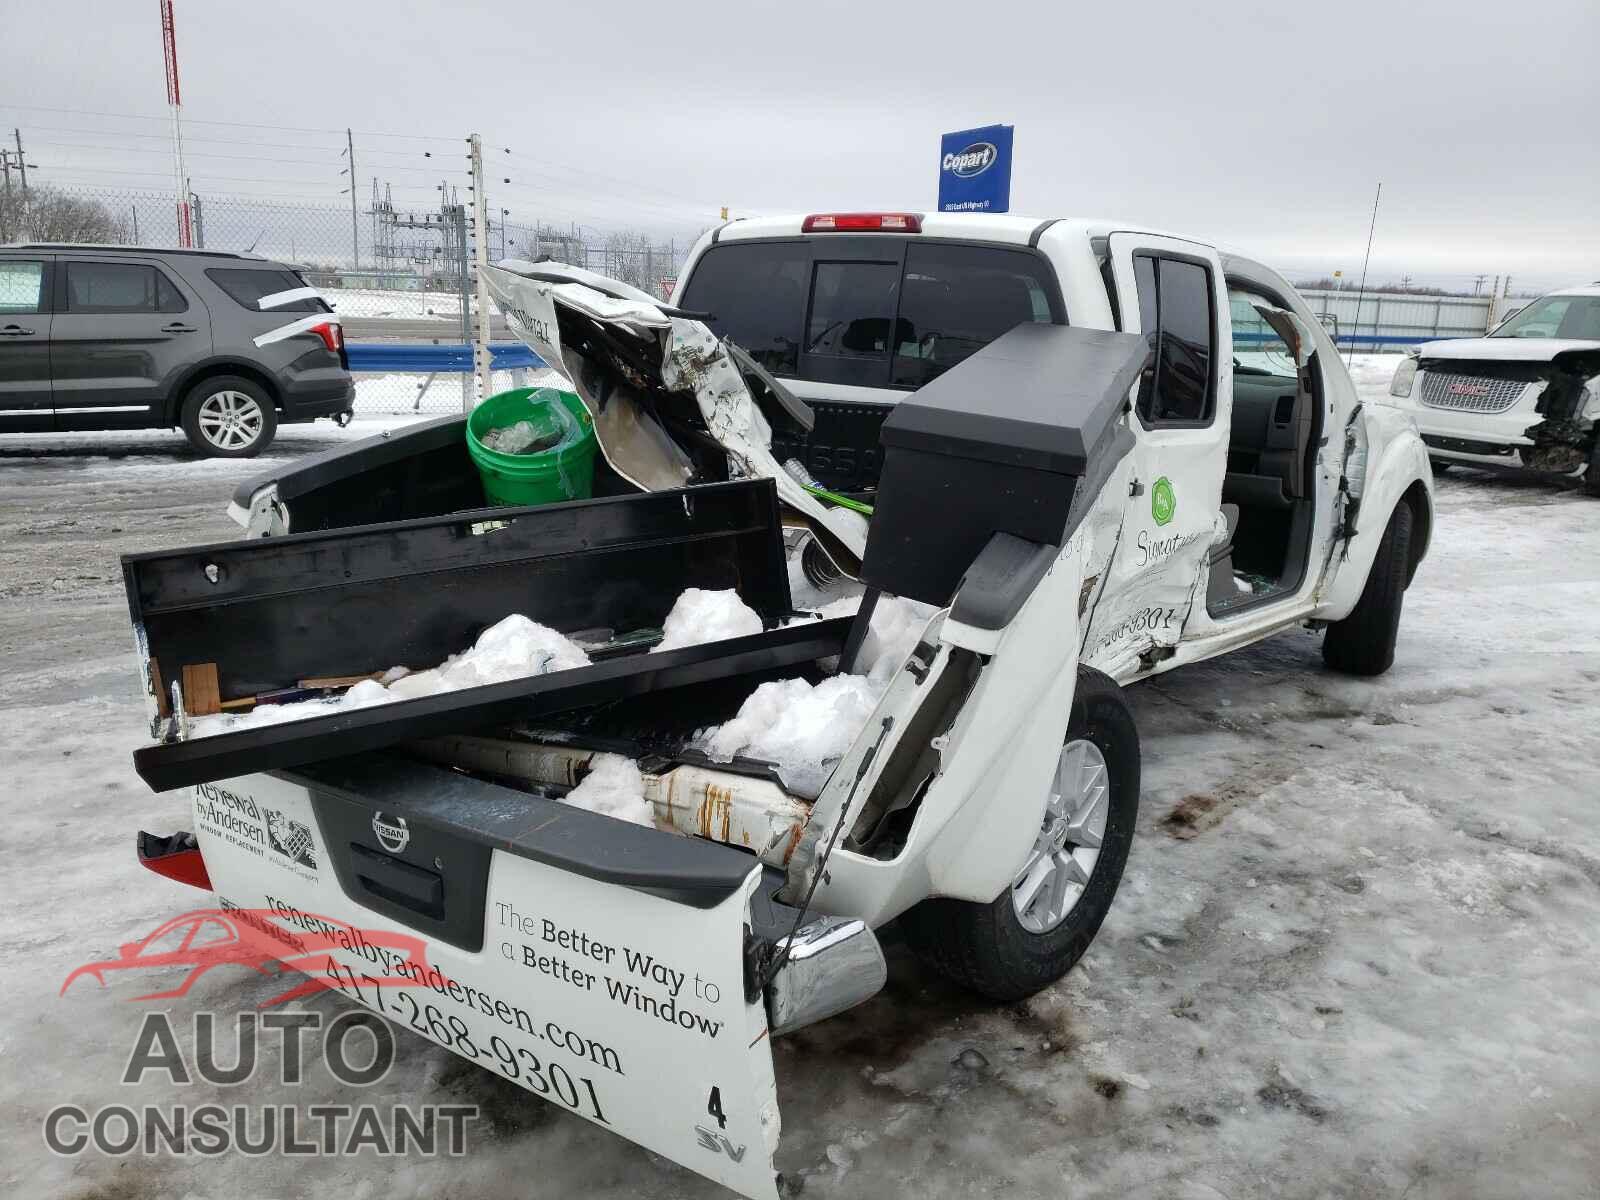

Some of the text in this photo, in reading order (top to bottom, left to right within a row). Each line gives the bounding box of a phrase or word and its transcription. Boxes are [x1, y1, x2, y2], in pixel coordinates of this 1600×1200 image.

[942, 147, 991, 171] Copart
[1449, 384, 1488, 397] GMC
[199, 822, 265, 857] WINDOW REPLACEMENT
[207, 801, 264, 846] Andersen
[496, 902, 720, 1003] The Better Way to
[265, 895, 626, 1076] renewalbyandersen.com
[501, 941, 721, 1038] a Better Window
[326, 955, 611, 1125] 417-268-9301
[707, 1085, 728, 1130] 4
[694, 1124, 746, 1163] SV
